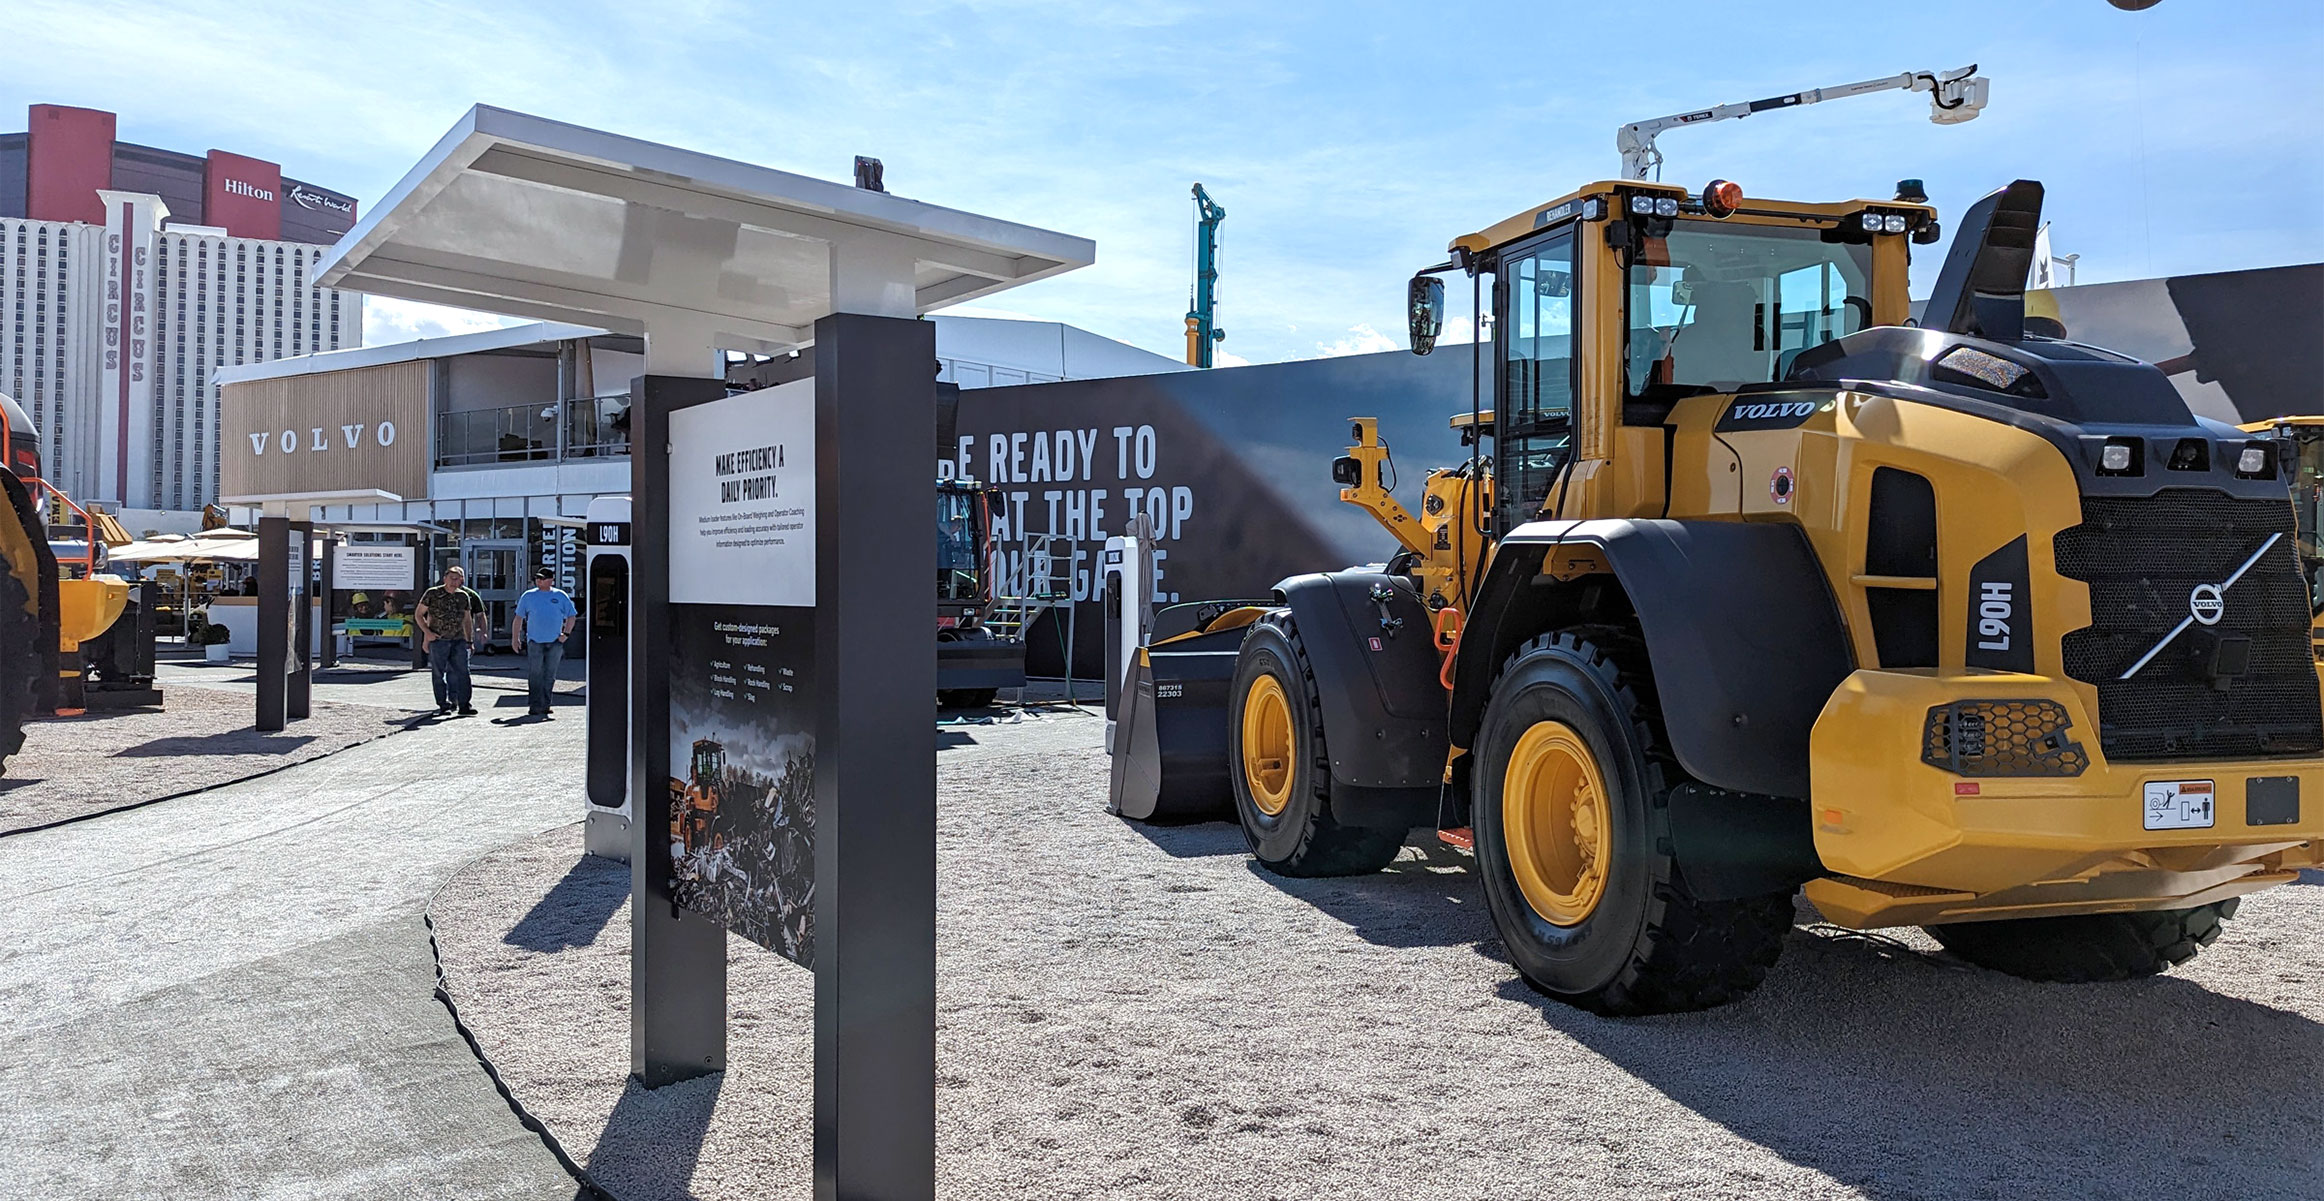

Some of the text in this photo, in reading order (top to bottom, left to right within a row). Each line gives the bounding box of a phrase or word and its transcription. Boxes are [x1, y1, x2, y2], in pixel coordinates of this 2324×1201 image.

[225, 179, 272, 201] Hilton
[325, 197, 352, 213] World
[106, 234, 120, 370] CIRCUS
[132, 247, 146, 382] CIRCUS
[1734, 402, 1816, 420] VOLVO
[250, 422, 395, 455] VOLVO
[990, 428, 1098, 484] READY
[1114, 424, 1156, 480] TO
[716, 444, 784, 476] MAKE EFFICIENCY A
[722, 476, 778, 503] DAILY PRIORITY.
[991, 486, 1193, 541] AT THE TOP
[600, 525, 618, 542] L90H
[984, 549, 1180, 602] OUR GAE.
[714, 622, 779, 637] Get custom-designed packages
[1978, 582, 2012, 650] L90H
[732, 636, 741, 645] your
[742, 636, 767, 647] application:
